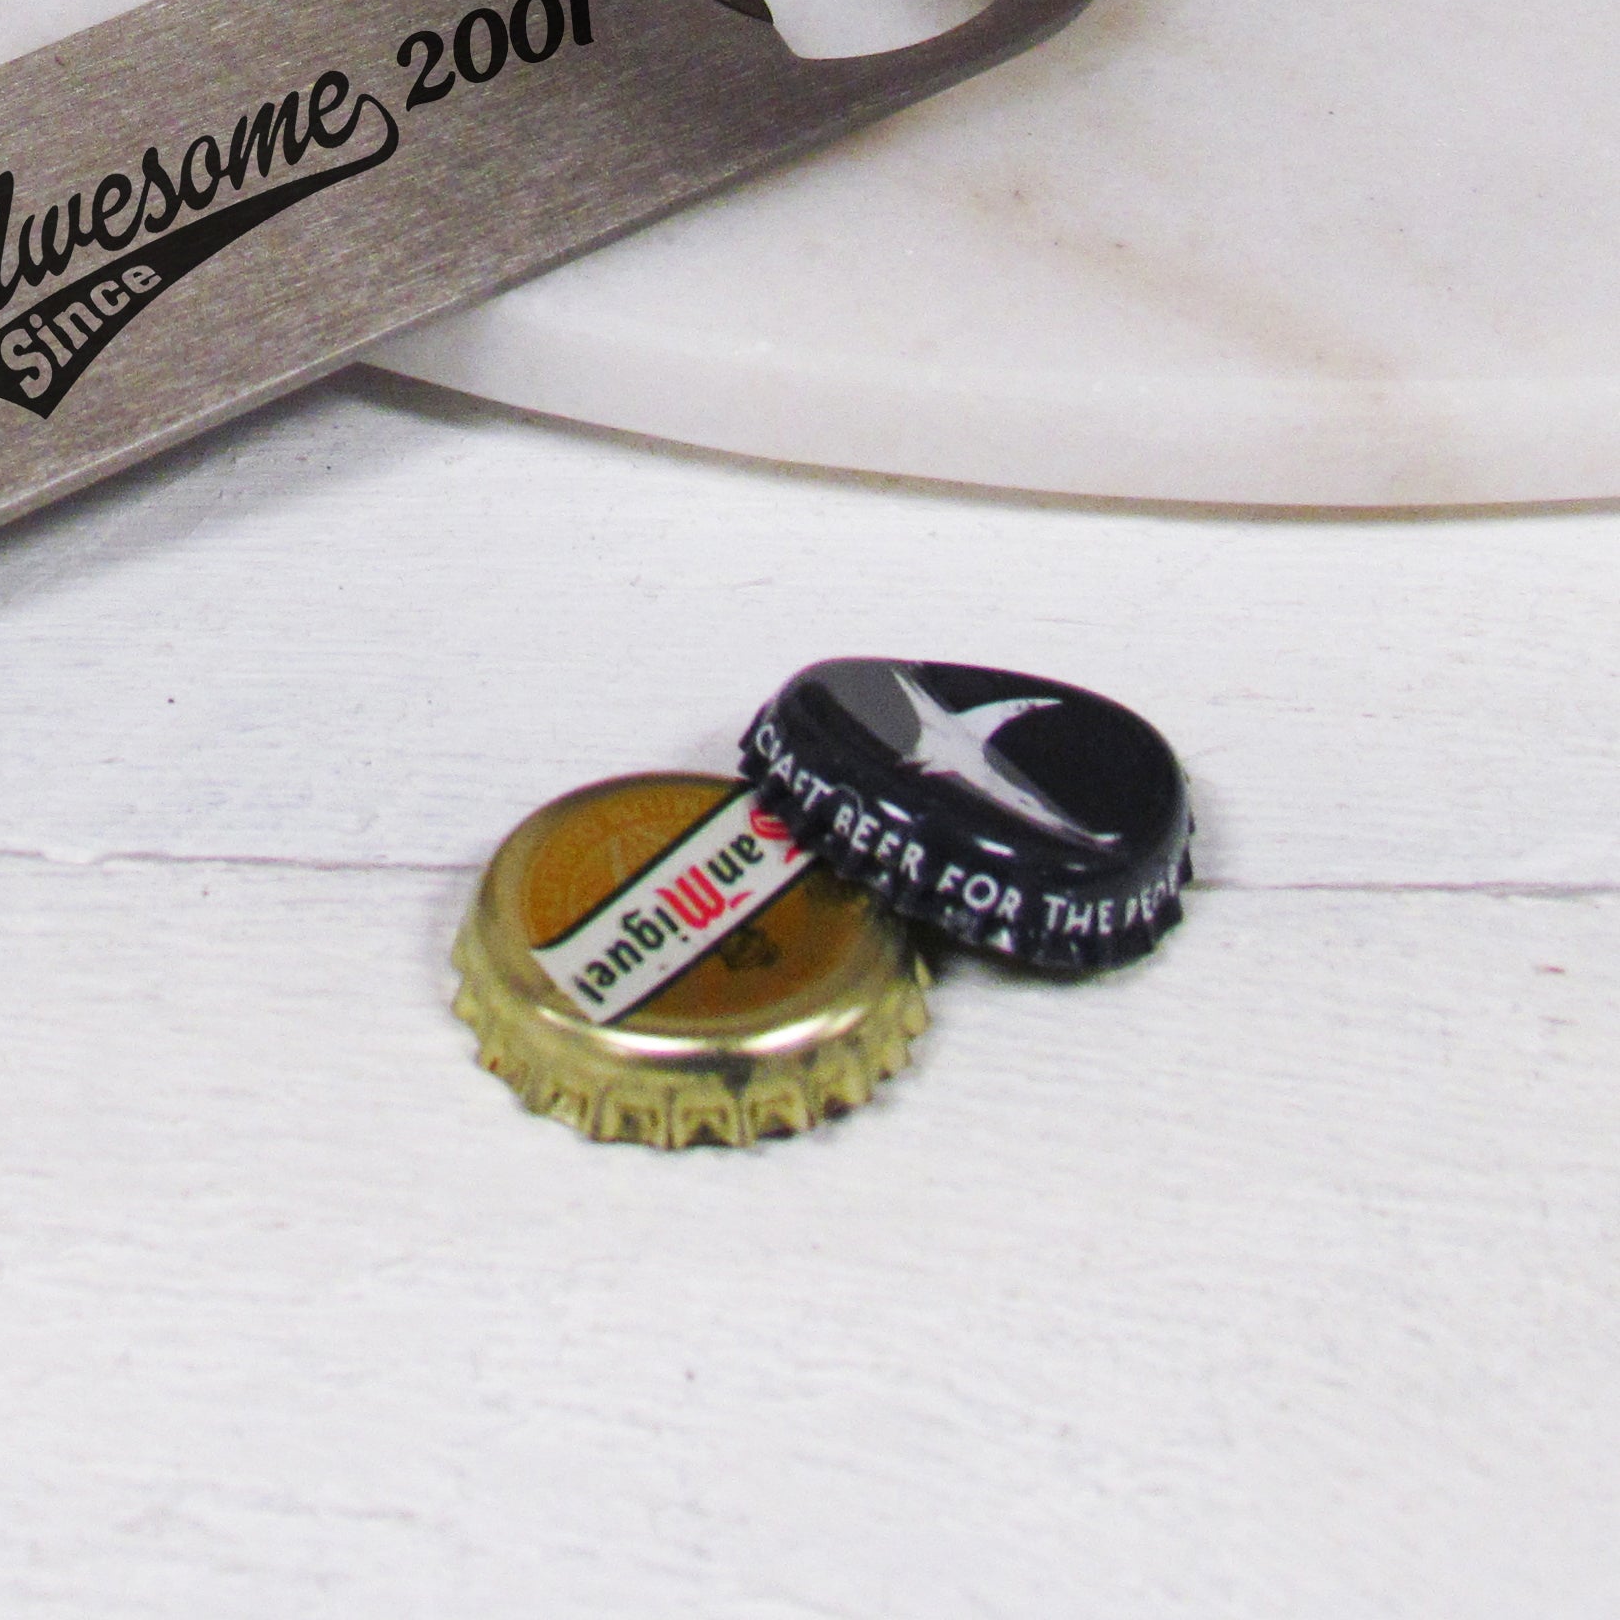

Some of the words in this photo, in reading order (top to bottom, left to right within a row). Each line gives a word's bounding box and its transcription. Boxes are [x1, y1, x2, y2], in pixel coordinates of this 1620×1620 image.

[0, 264, 163, 400] Since
[573, 864, 756, 1005] Miguel
[833, 804, 927, 883] BEER
[936, 863, 1023, 923] FOR
[1041, 892, 1117, 937] THE
